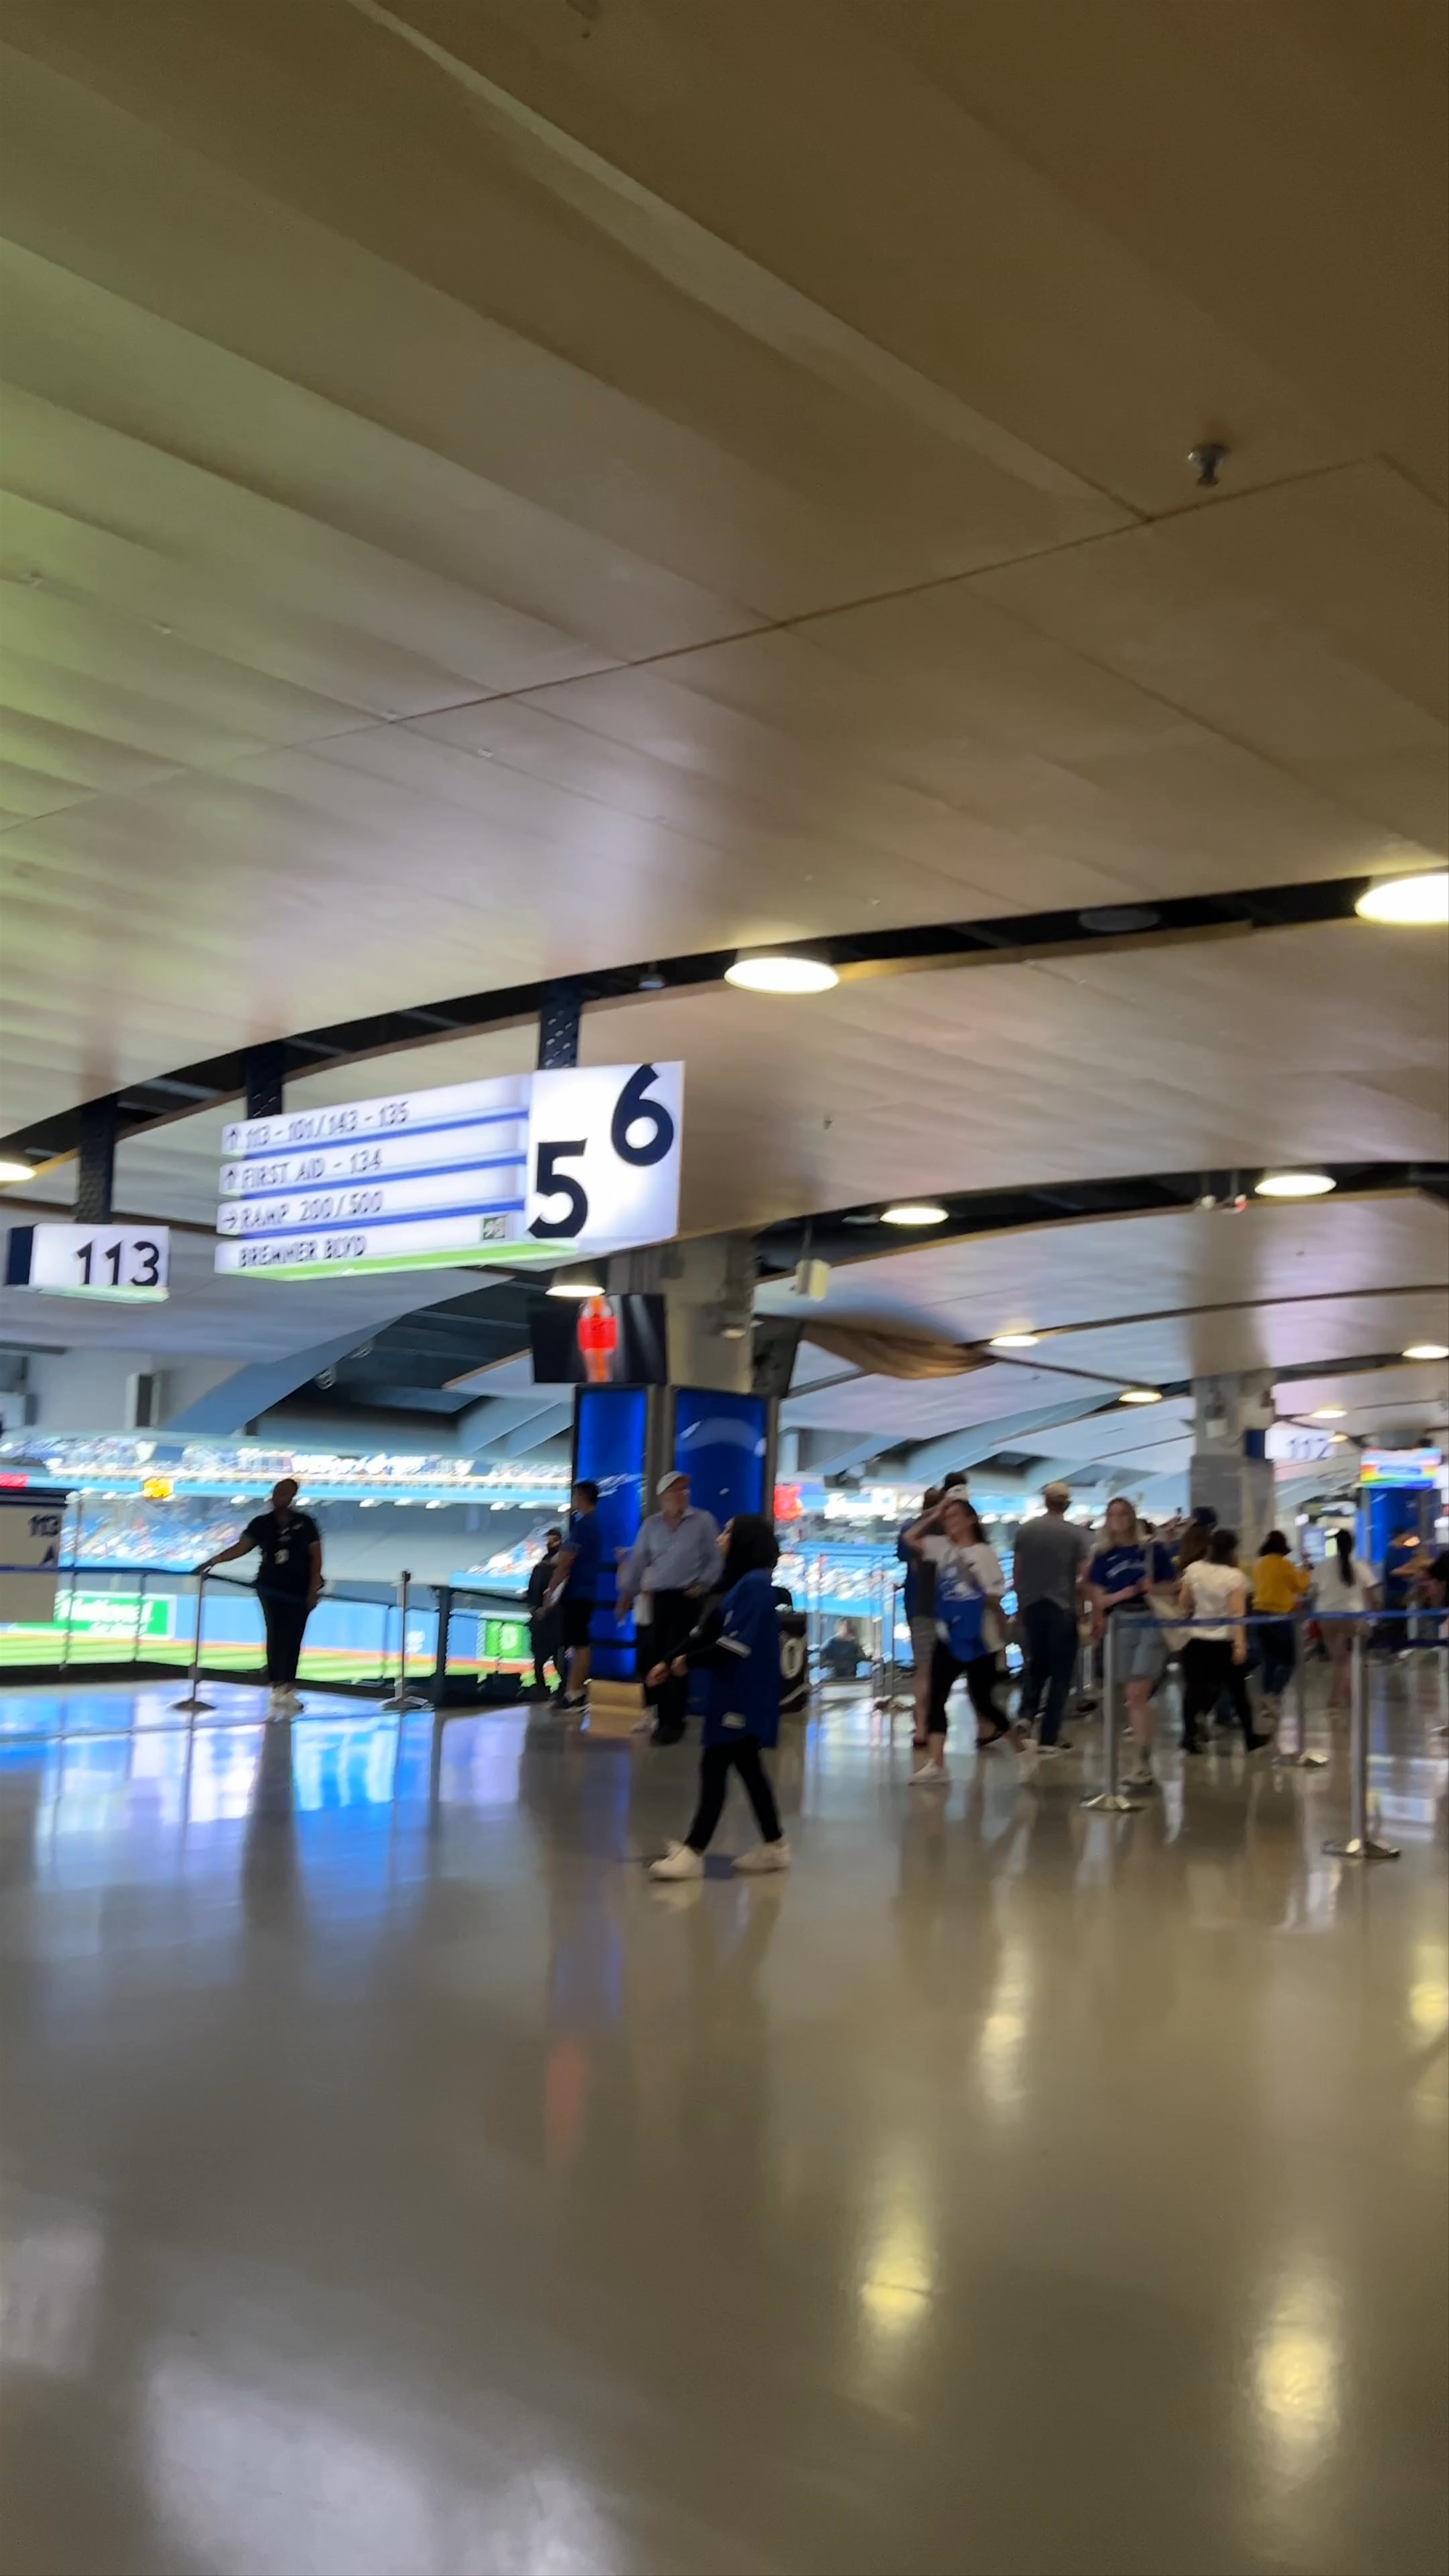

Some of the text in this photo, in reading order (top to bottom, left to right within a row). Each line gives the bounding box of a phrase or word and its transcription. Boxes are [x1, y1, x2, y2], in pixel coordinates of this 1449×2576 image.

[246, 1124, 270, 1148] 113
[379, 1101, 409, 1127] 135
[611, 1063, 674, 1167] 6
[242, 1161, 289, 1189] FIRST
[295, 1157, 325, 1181] AID
[350, 1148, 383, 1174] 134
[528, 1138, 588, 1238] 5
[241, 1202, 290, 1230] RAMP
[73, 1239, 159, 1286] 113
[325, 1235, 366, 1260] BLVD
[28, 1514, 61, 1537] 113
